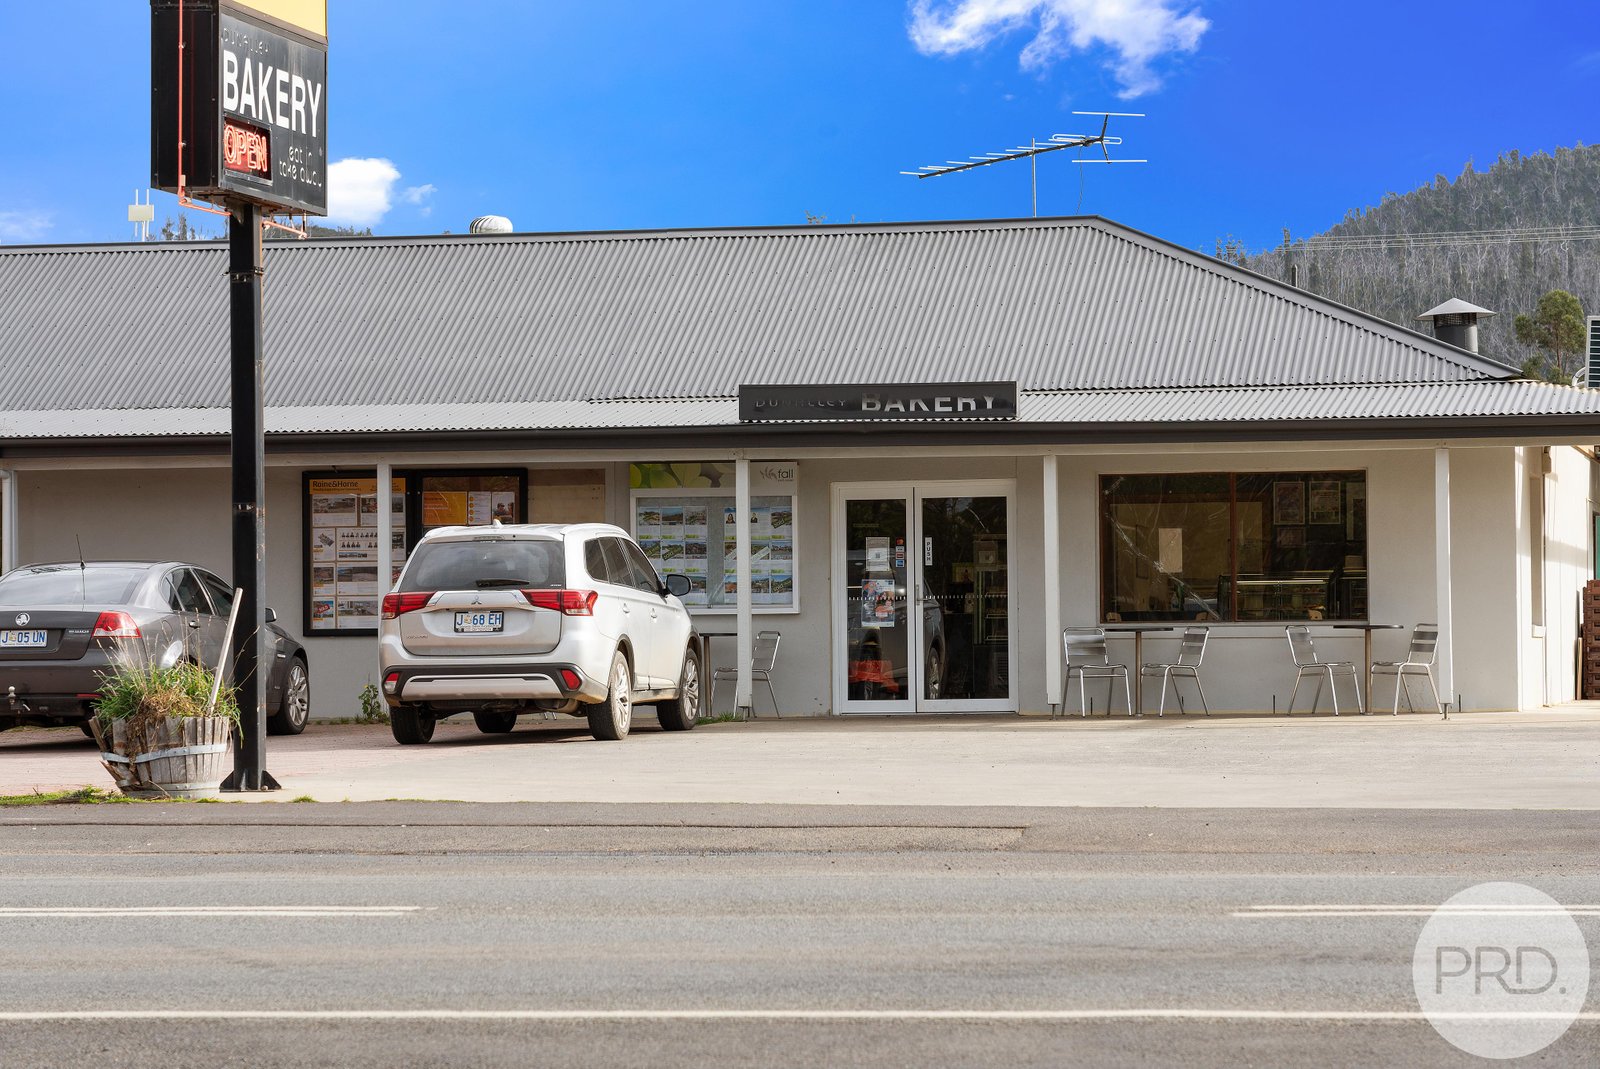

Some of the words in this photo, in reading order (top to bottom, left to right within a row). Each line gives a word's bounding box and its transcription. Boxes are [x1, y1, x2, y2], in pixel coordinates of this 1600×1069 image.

[223, 50, 322, 138] BAKERY
[224, 124, 268, 172] OPEN
[456, 614, 464, 625] J
[472, 614, 485, 625] 68
[488, 613, 502, 625] EH
[2, 632, 9, 643] J
[17, 632, 30, 643] 05
[32, 632, 46, 643] UN
